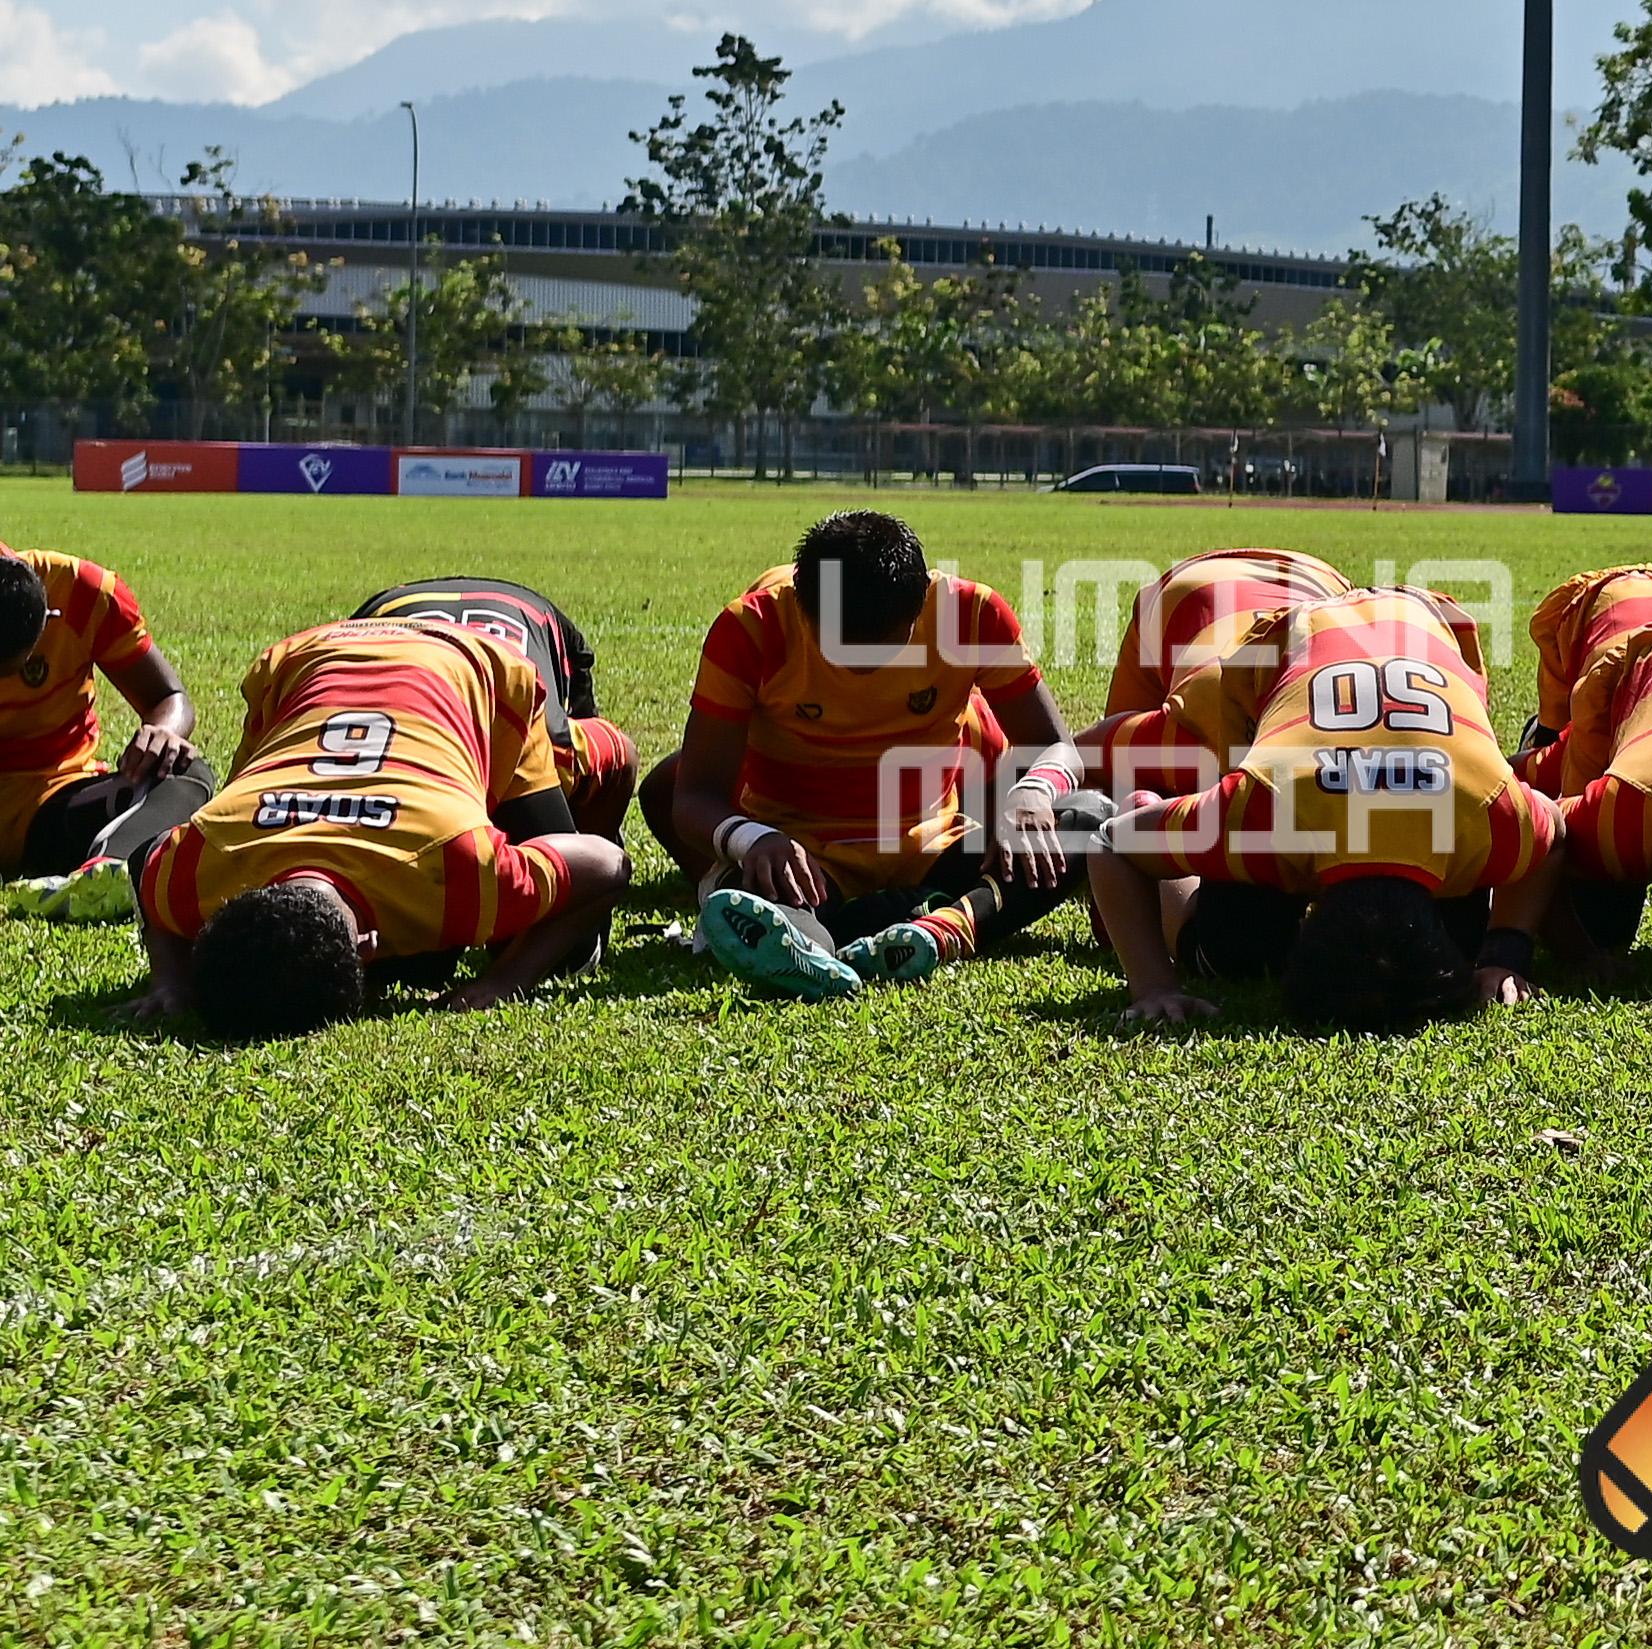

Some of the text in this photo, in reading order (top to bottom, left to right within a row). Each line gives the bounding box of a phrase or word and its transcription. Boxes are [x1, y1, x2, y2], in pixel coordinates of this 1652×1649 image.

[1308, 658, 1454, 736] 50
[1314, 747, 1452, 795] SDAR
[254, 792, 400, 828] SDAR
